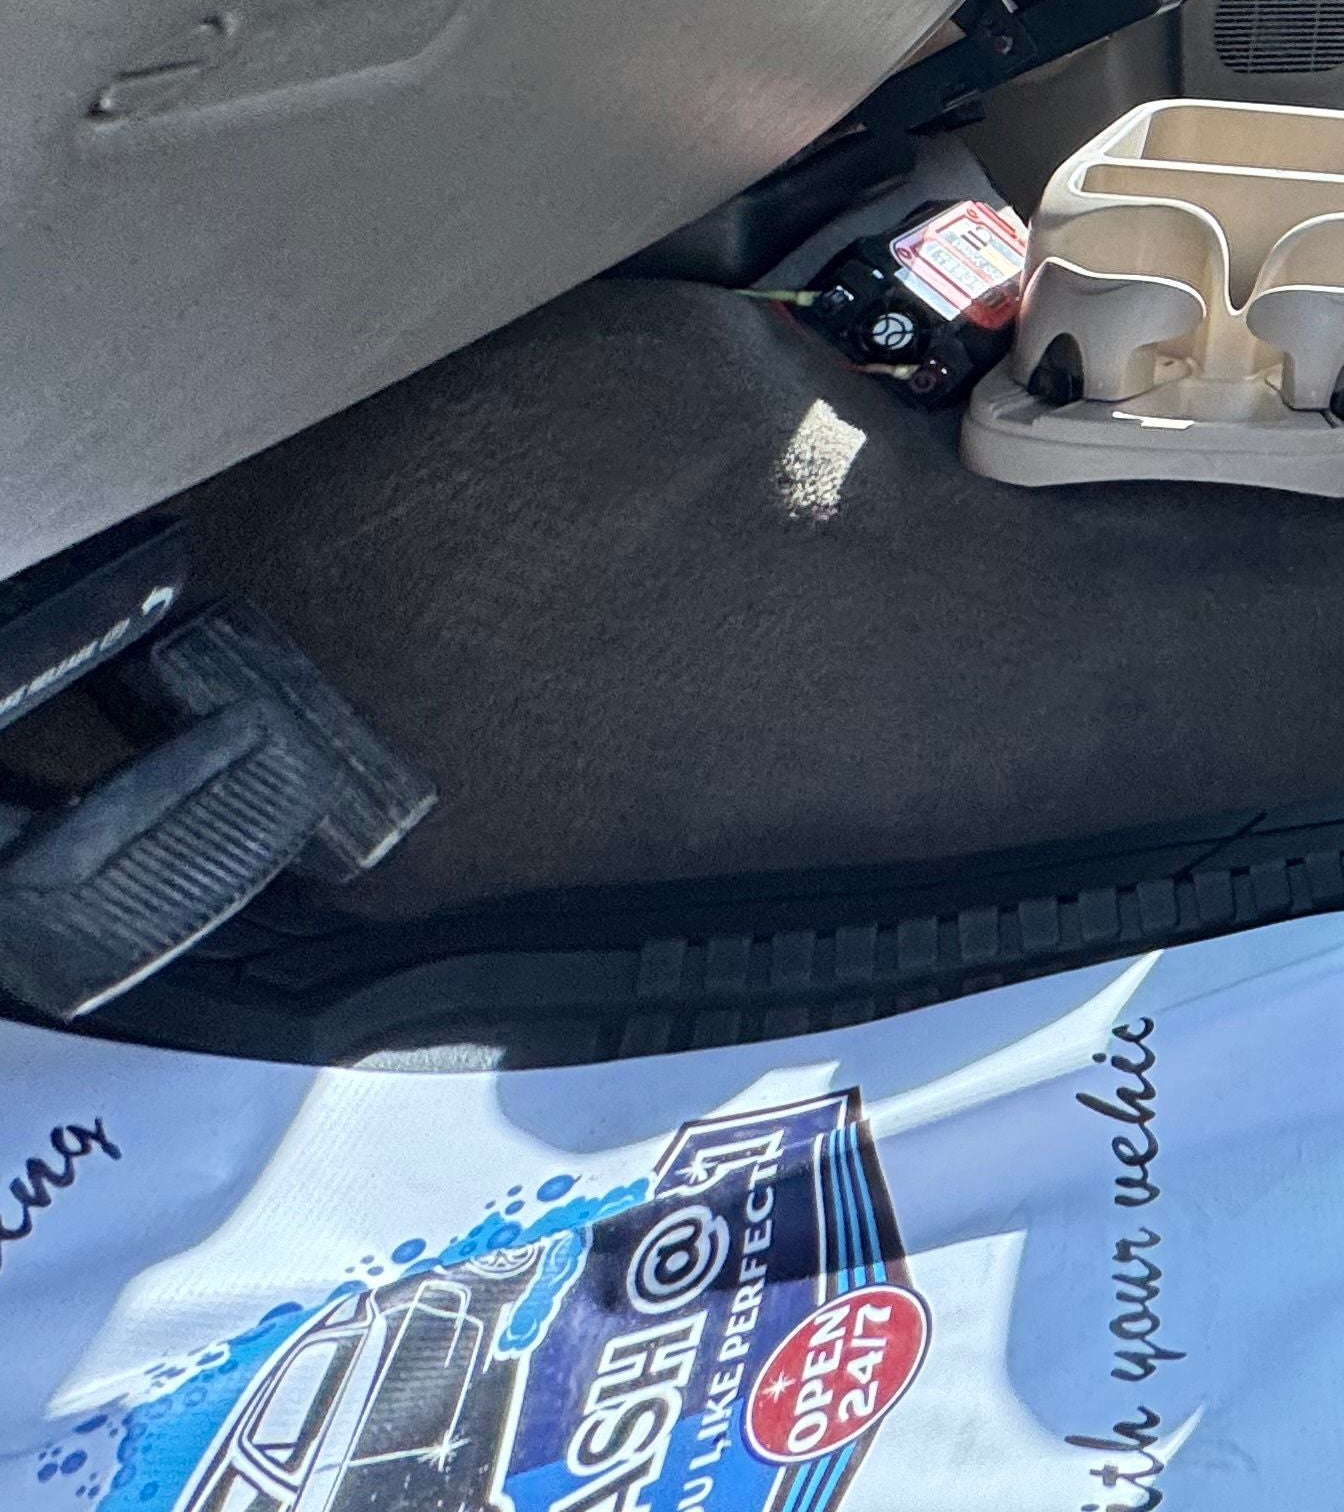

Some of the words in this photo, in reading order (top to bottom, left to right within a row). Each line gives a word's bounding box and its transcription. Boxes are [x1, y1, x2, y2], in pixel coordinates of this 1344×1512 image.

[838, 1303, 892, 1423] 24/7
[1109, 1226, 1187, 1382] your
[688, 1363, 745, 1470] LIKE
[787, 1304, 850, 1453] OPEN
